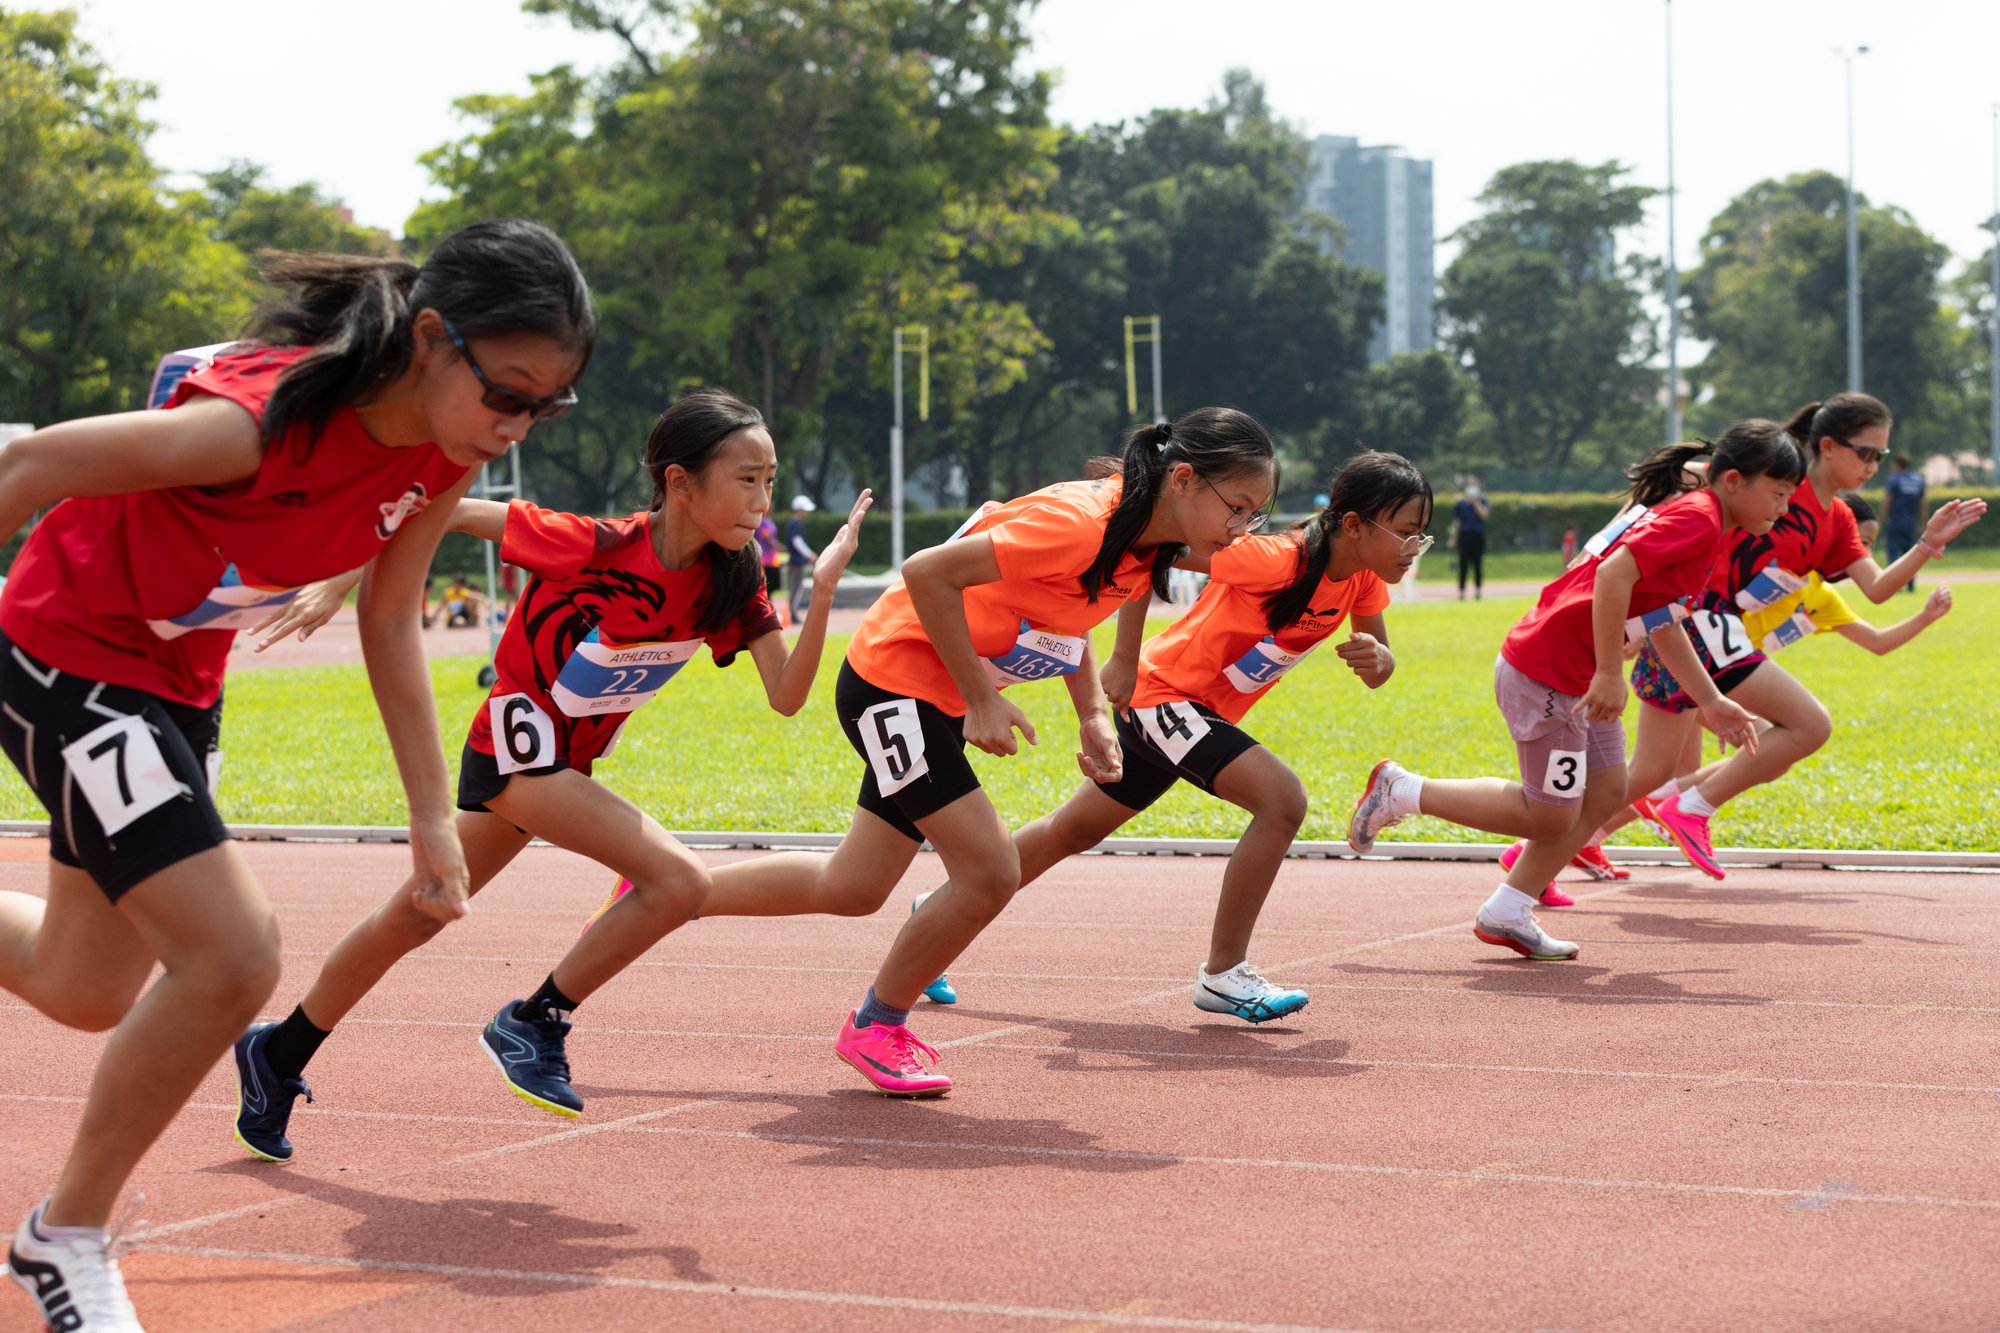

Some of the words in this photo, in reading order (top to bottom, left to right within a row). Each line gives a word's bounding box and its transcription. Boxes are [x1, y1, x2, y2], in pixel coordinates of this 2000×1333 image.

[1036, 635, 1073, 656] ATHLETICS
[1708, 612, 1743, 656] 2
[609, 650, 674, 663] ATHLETICS
[1003, 653, 1064, 678] 1631
[600, 668, 649, 694] 22
[503, 697, 541, 765] 6
[1156, 702, 1194, 741] 4
[873, 707, 912, 781] 5
[87, 730, 135, 807] 7
[1552, 756, 1578, 791] 3
[9, 1247, 83, 1333] AIR
